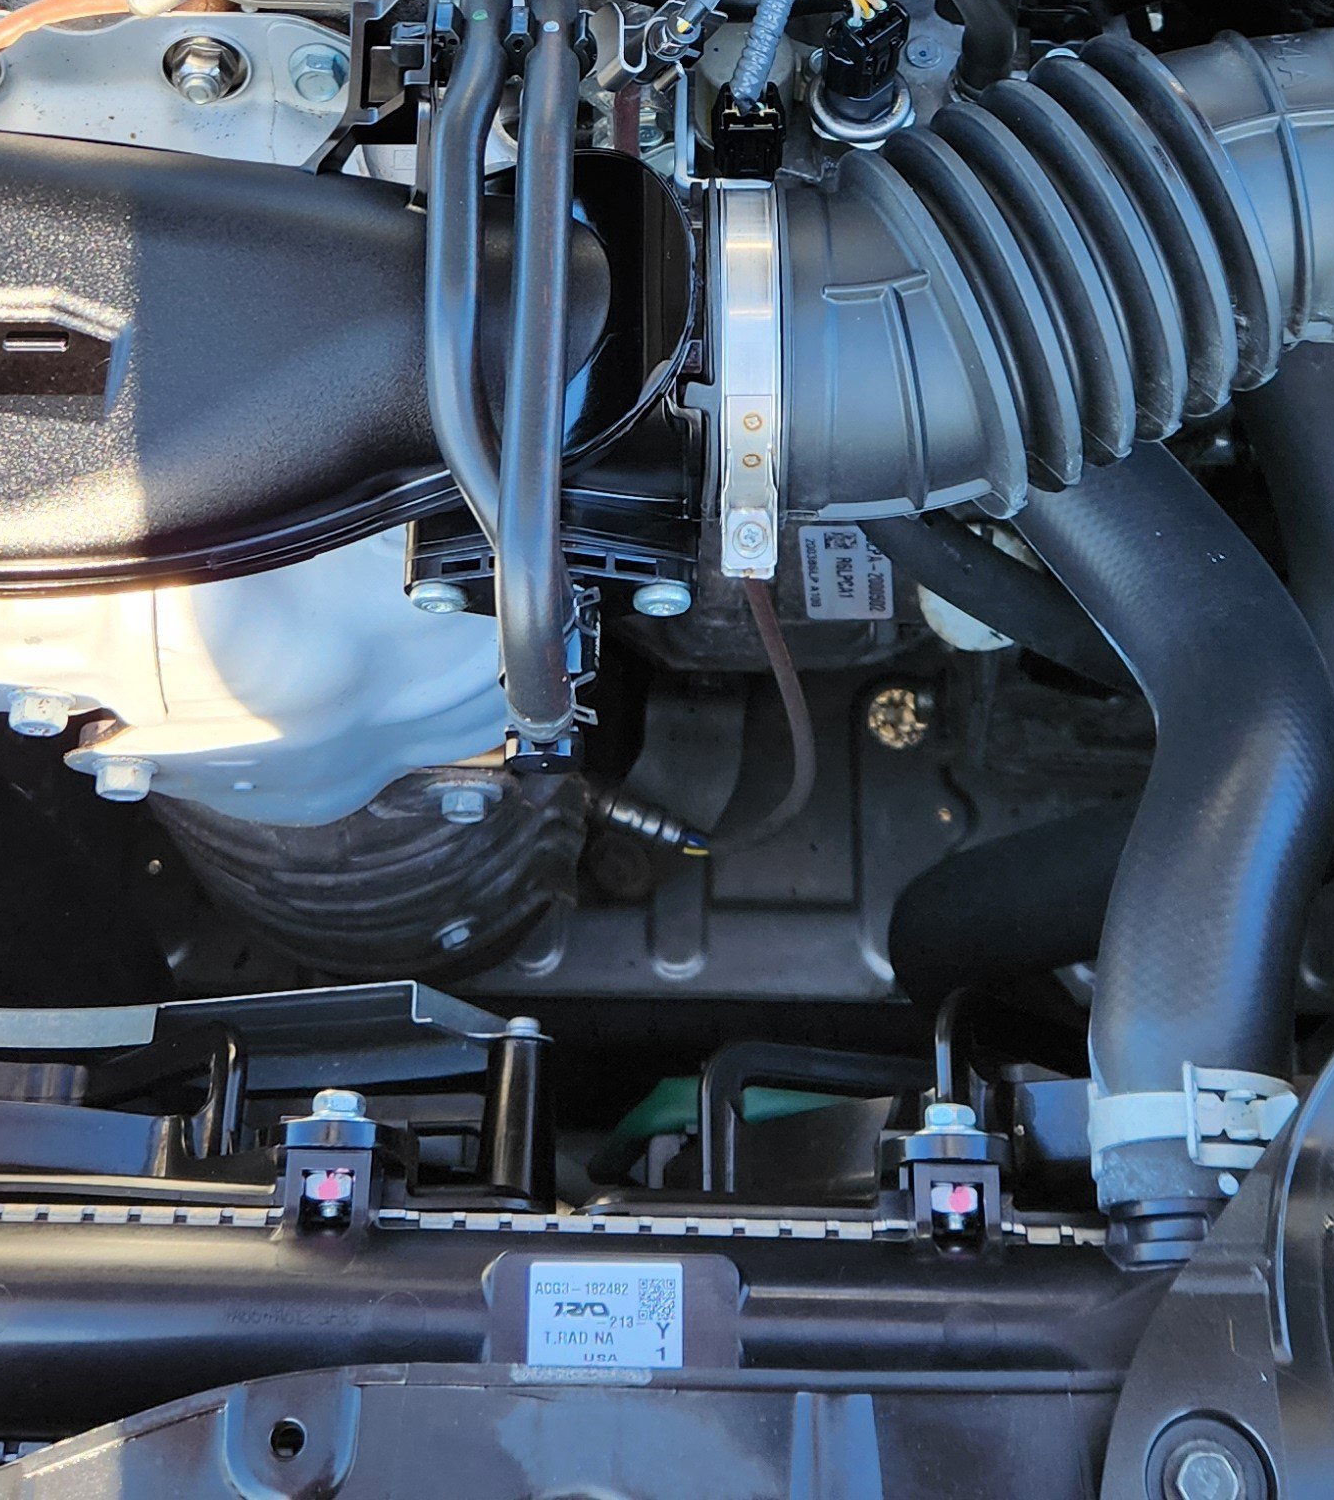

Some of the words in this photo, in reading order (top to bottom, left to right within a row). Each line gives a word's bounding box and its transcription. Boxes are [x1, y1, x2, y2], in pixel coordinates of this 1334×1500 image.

[656, 1321, 671, 1340] Y
[544, 1331, 588, 1345] T.RAD
[595, 1332, 614, 1345] NA
[584, 1353, 618, 1363] USA
[656, 1347, 666, 1361] 1
